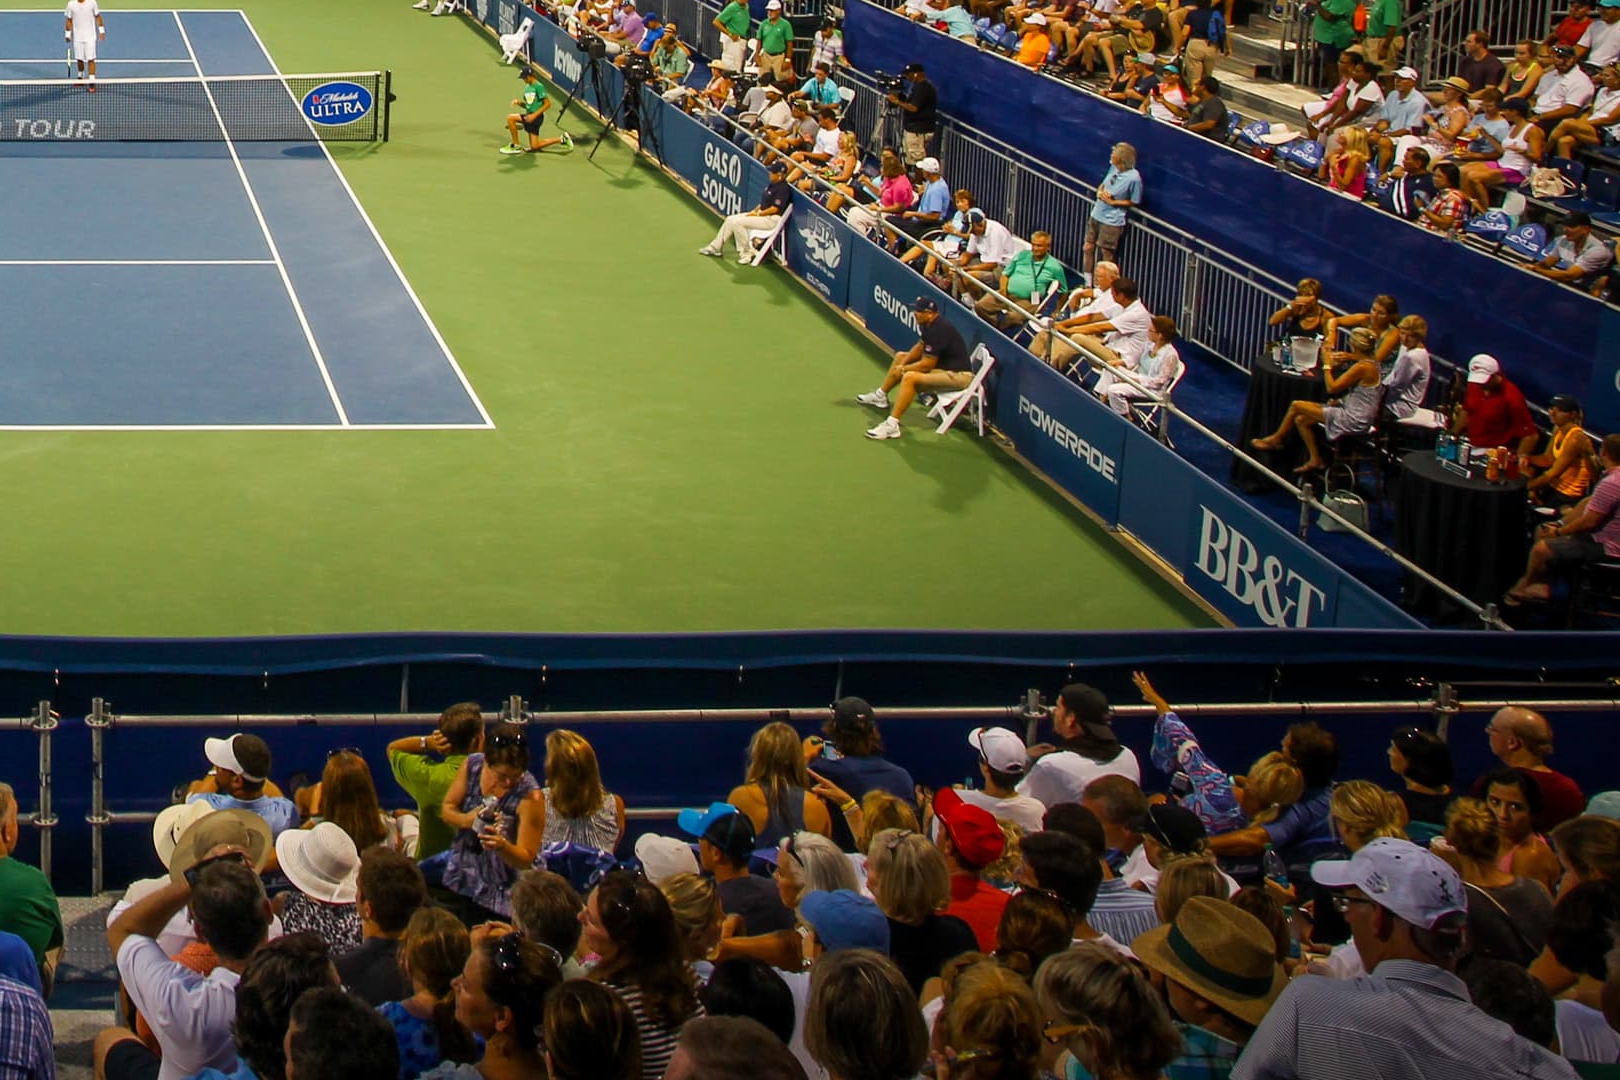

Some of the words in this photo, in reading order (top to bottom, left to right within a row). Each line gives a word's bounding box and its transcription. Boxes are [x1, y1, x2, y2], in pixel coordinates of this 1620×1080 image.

[311, 100, 365, 118] ULTRA
[15, 119, 97, 138] TOUR
[704, 141, 728, 178] GAS
[701, 173, 742, 216] SOUTH
[1505, 233, 1540, 253] LEXUS
[1018, 394, 1116, 484] POWERADE
[1194, 504, 1326, 629] BB&T
